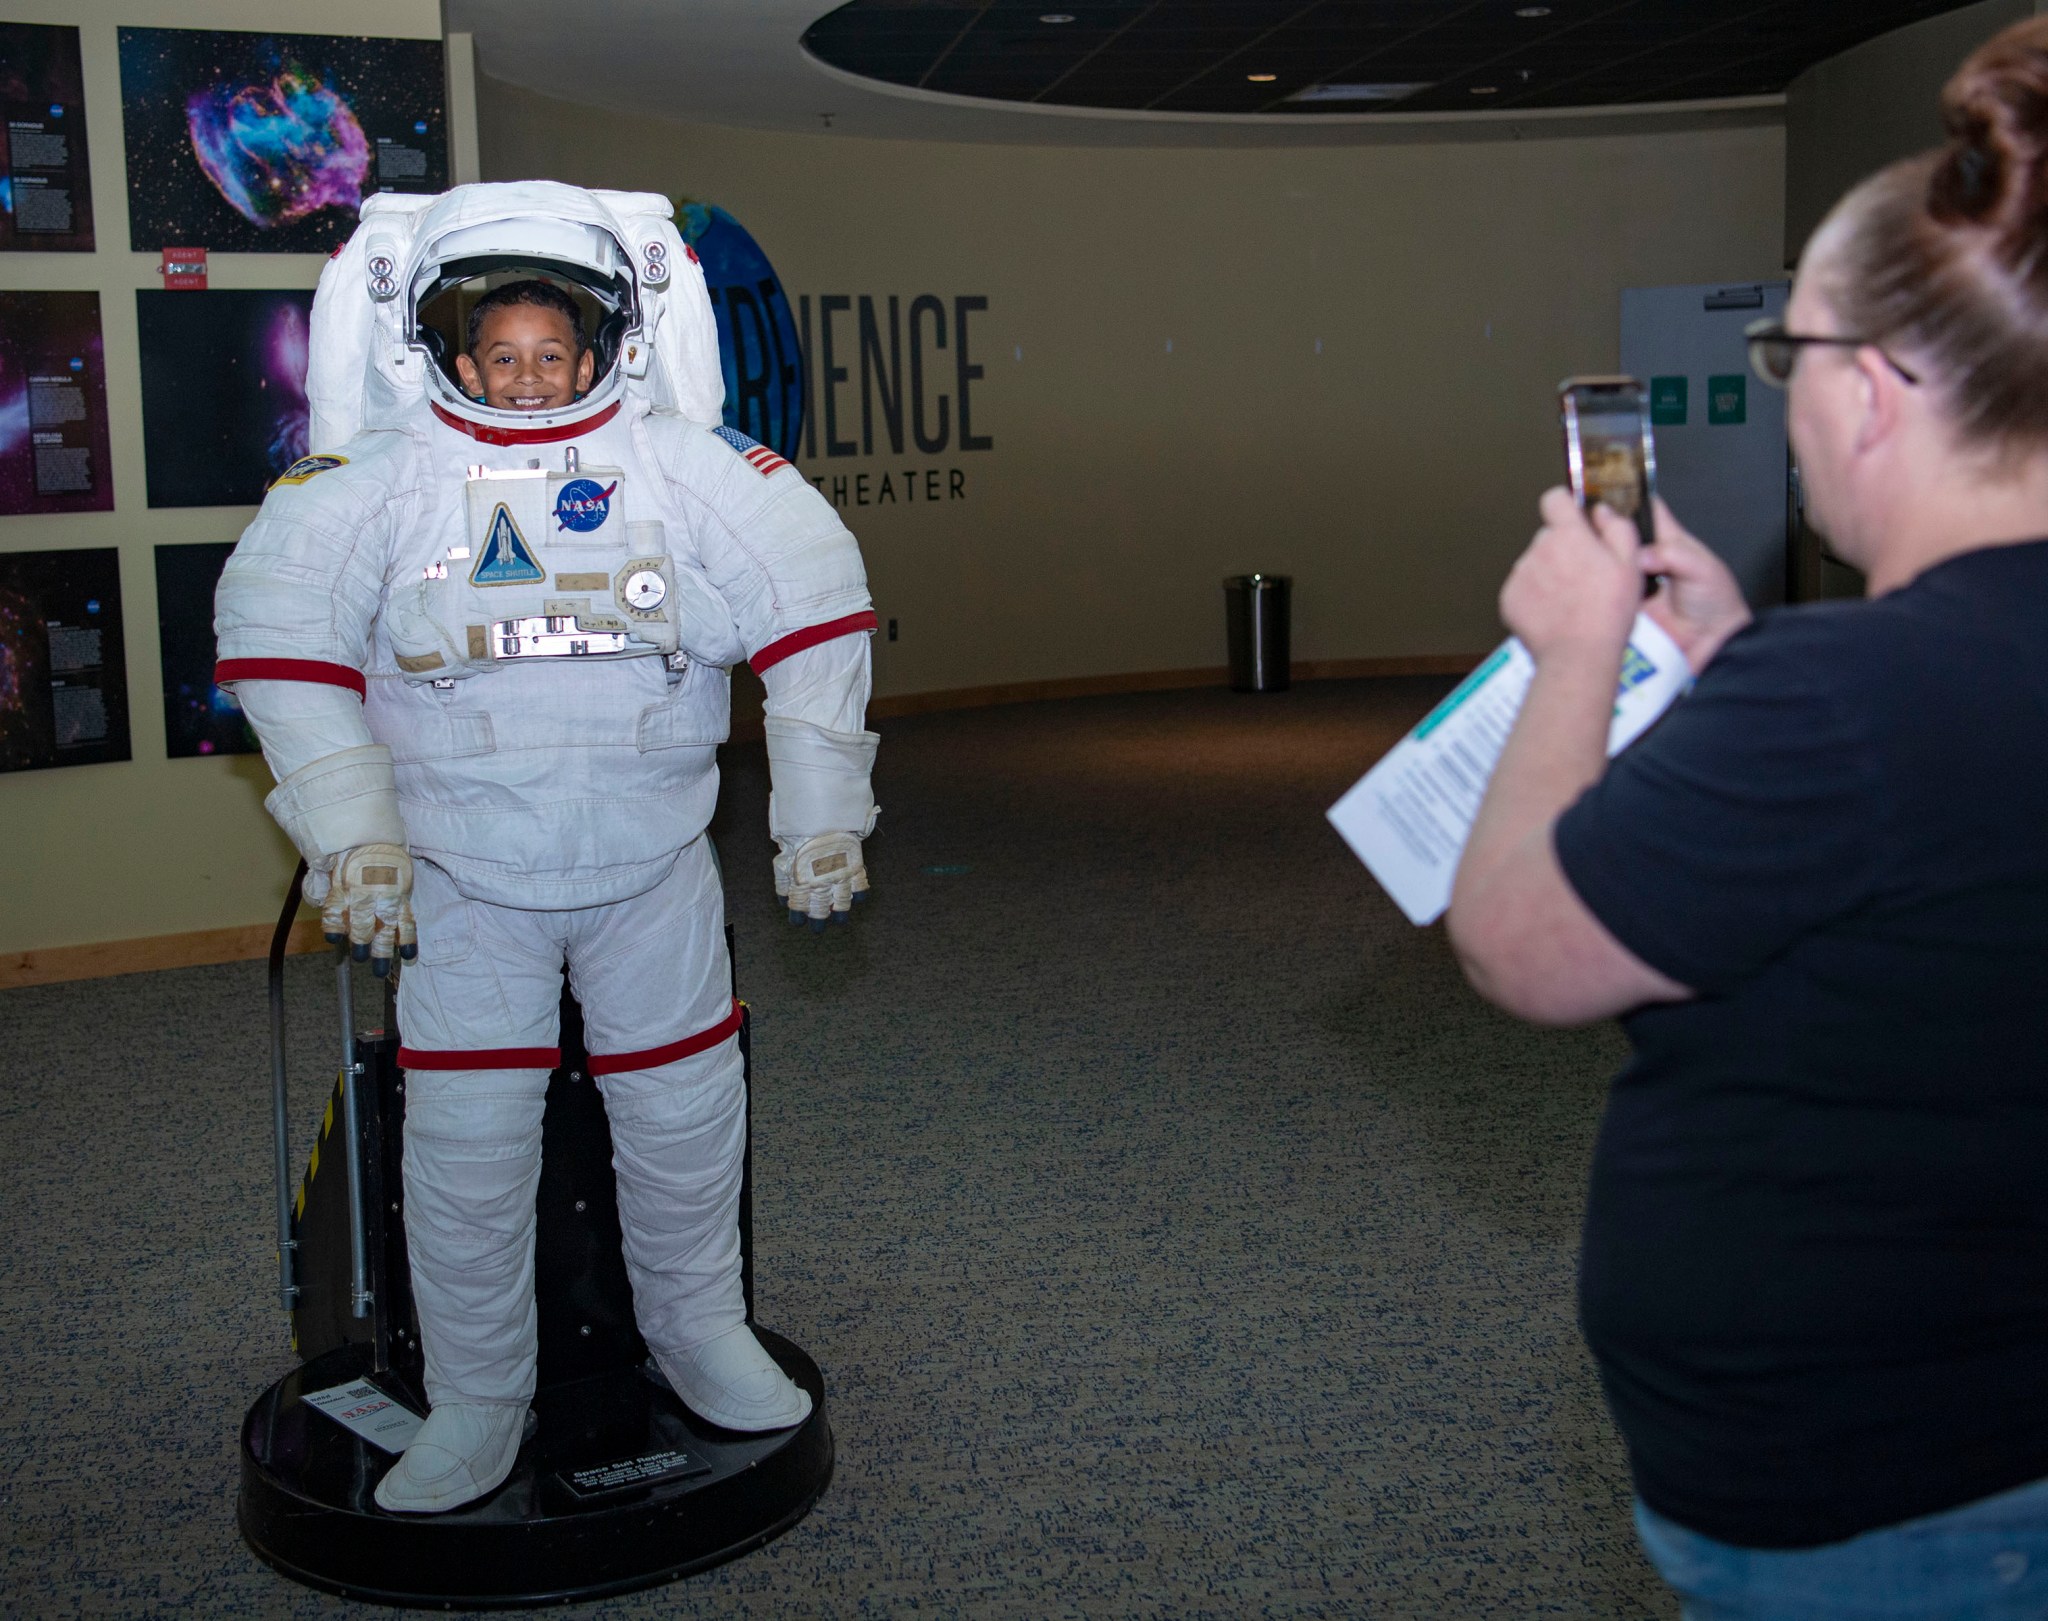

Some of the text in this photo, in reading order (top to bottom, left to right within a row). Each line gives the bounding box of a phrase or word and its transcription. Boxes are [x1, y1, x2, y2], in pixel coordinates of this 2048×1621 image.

[561, 499, 607, 512] NASA
[480, 569, 536, 579] SPACE SHUTTLE
[342, 1400, 392, 1419] NASA
[574, 1451, 677, 1478] Space Suit Replica
